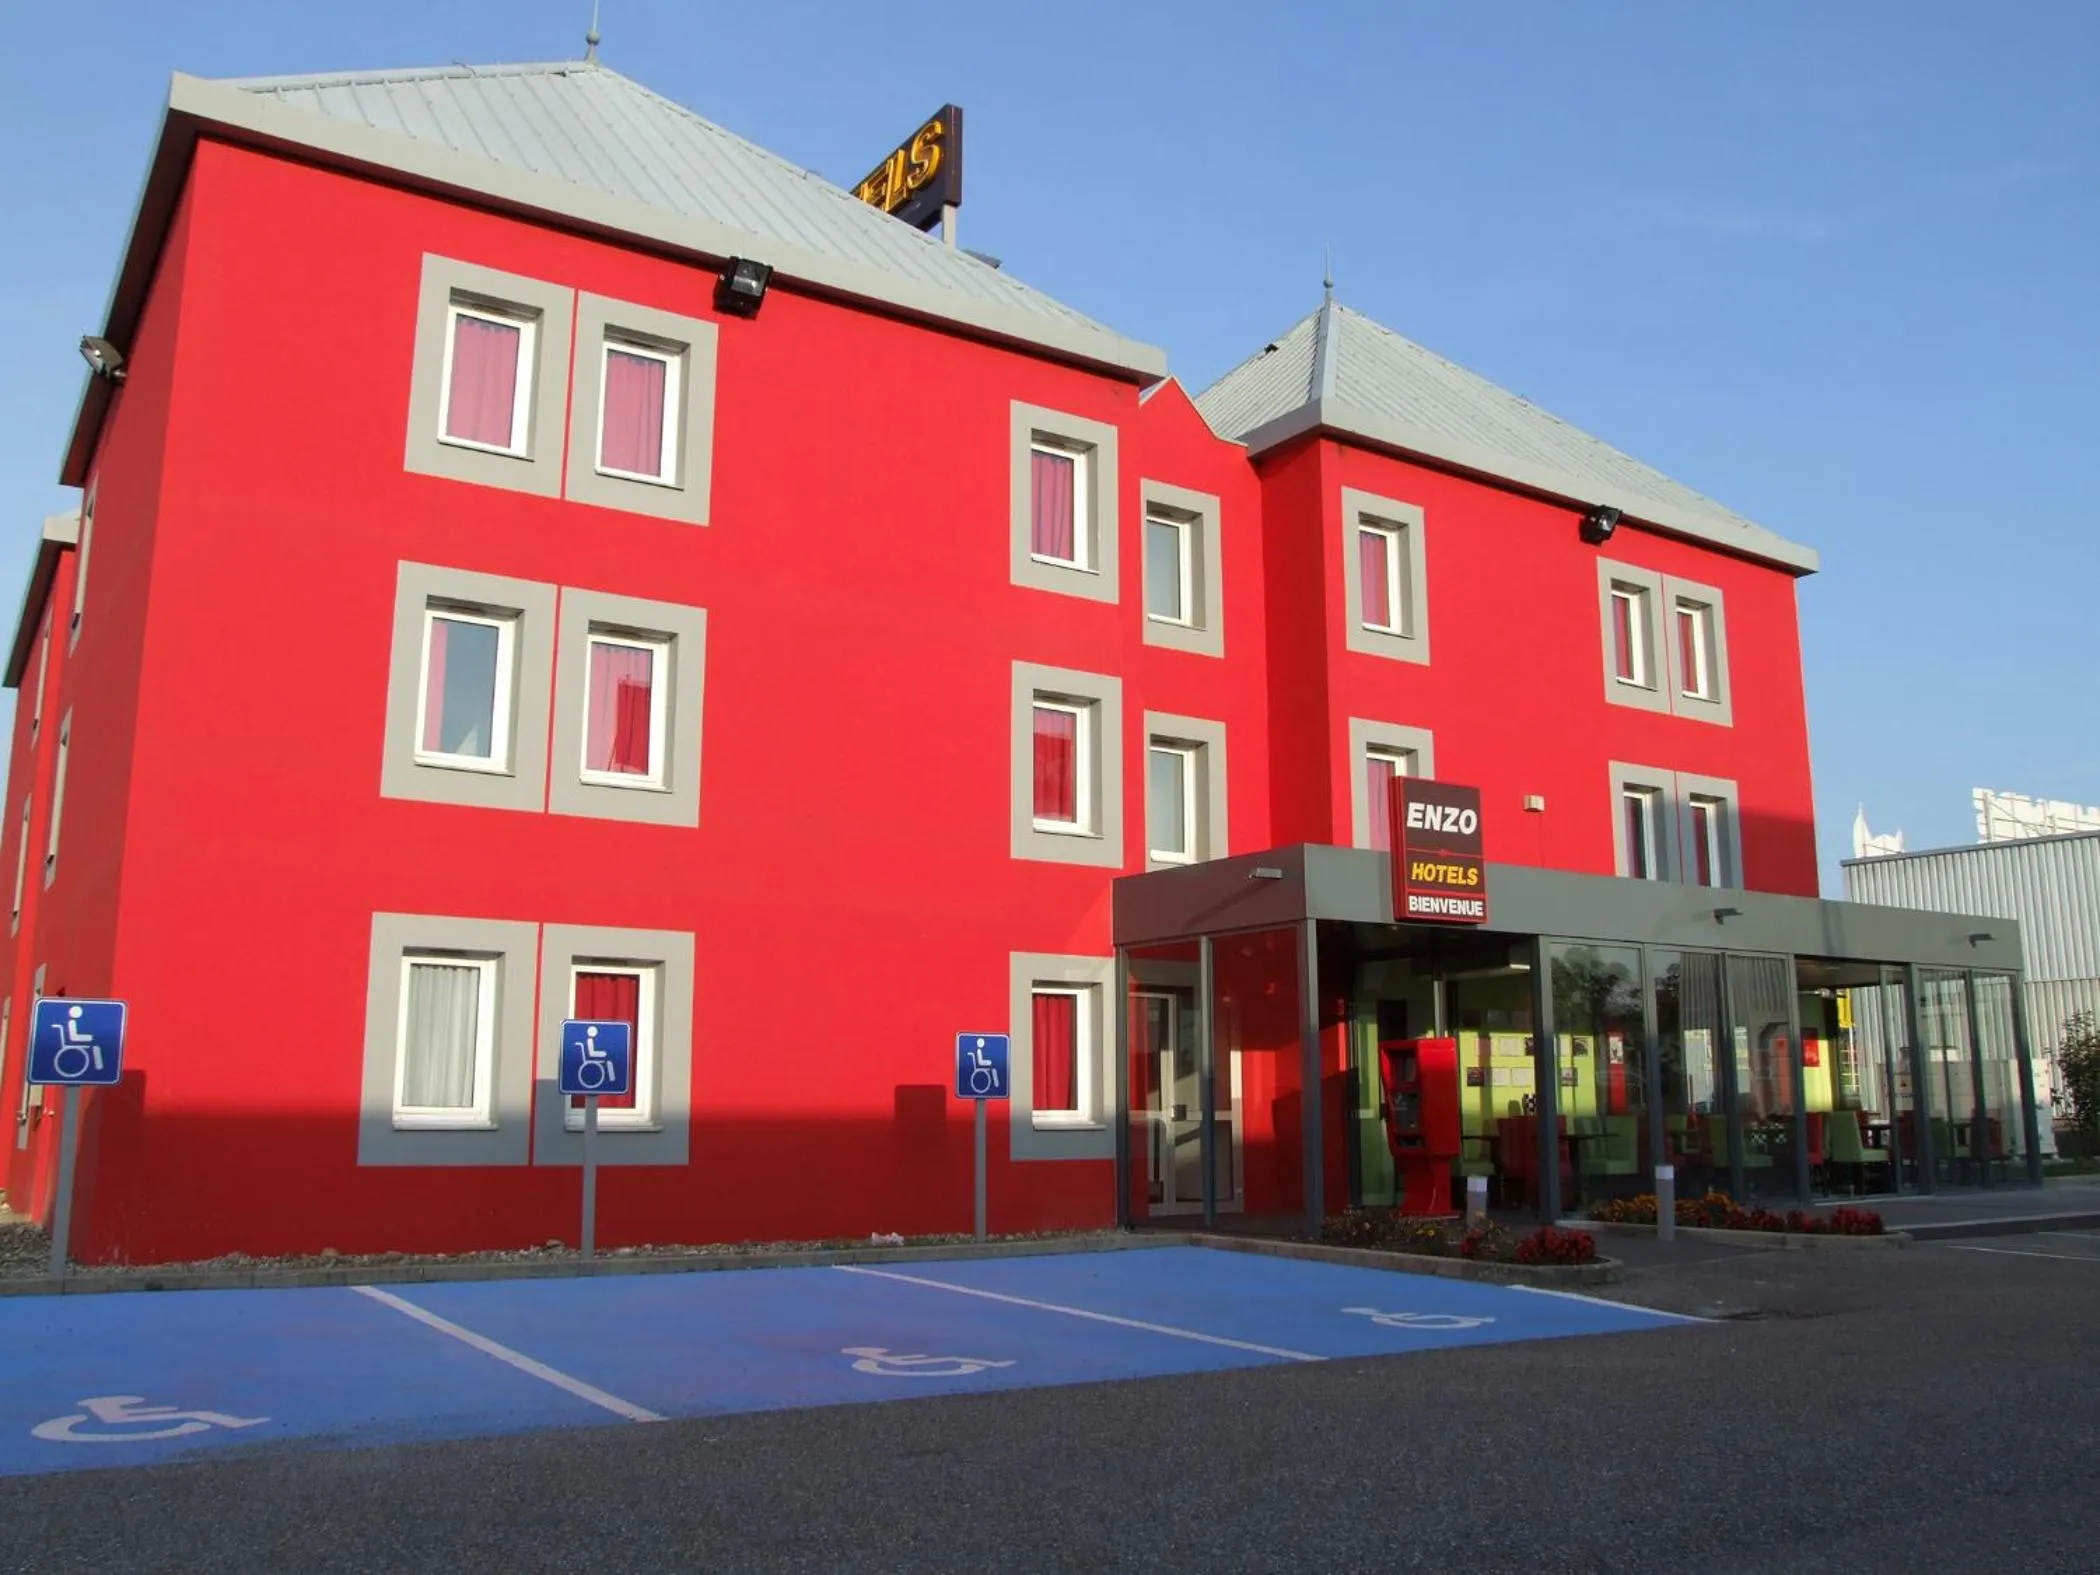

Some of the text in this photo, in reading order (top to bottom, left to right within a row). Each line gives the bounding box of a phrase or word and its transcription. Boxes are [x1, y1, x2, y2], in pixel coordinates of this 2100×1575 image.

[1406, 801, 1478, 835] ENZO
[1411, 862, 1479, 886] HOTELS
[1408, 895, 1484, 917] BIENVENUE
